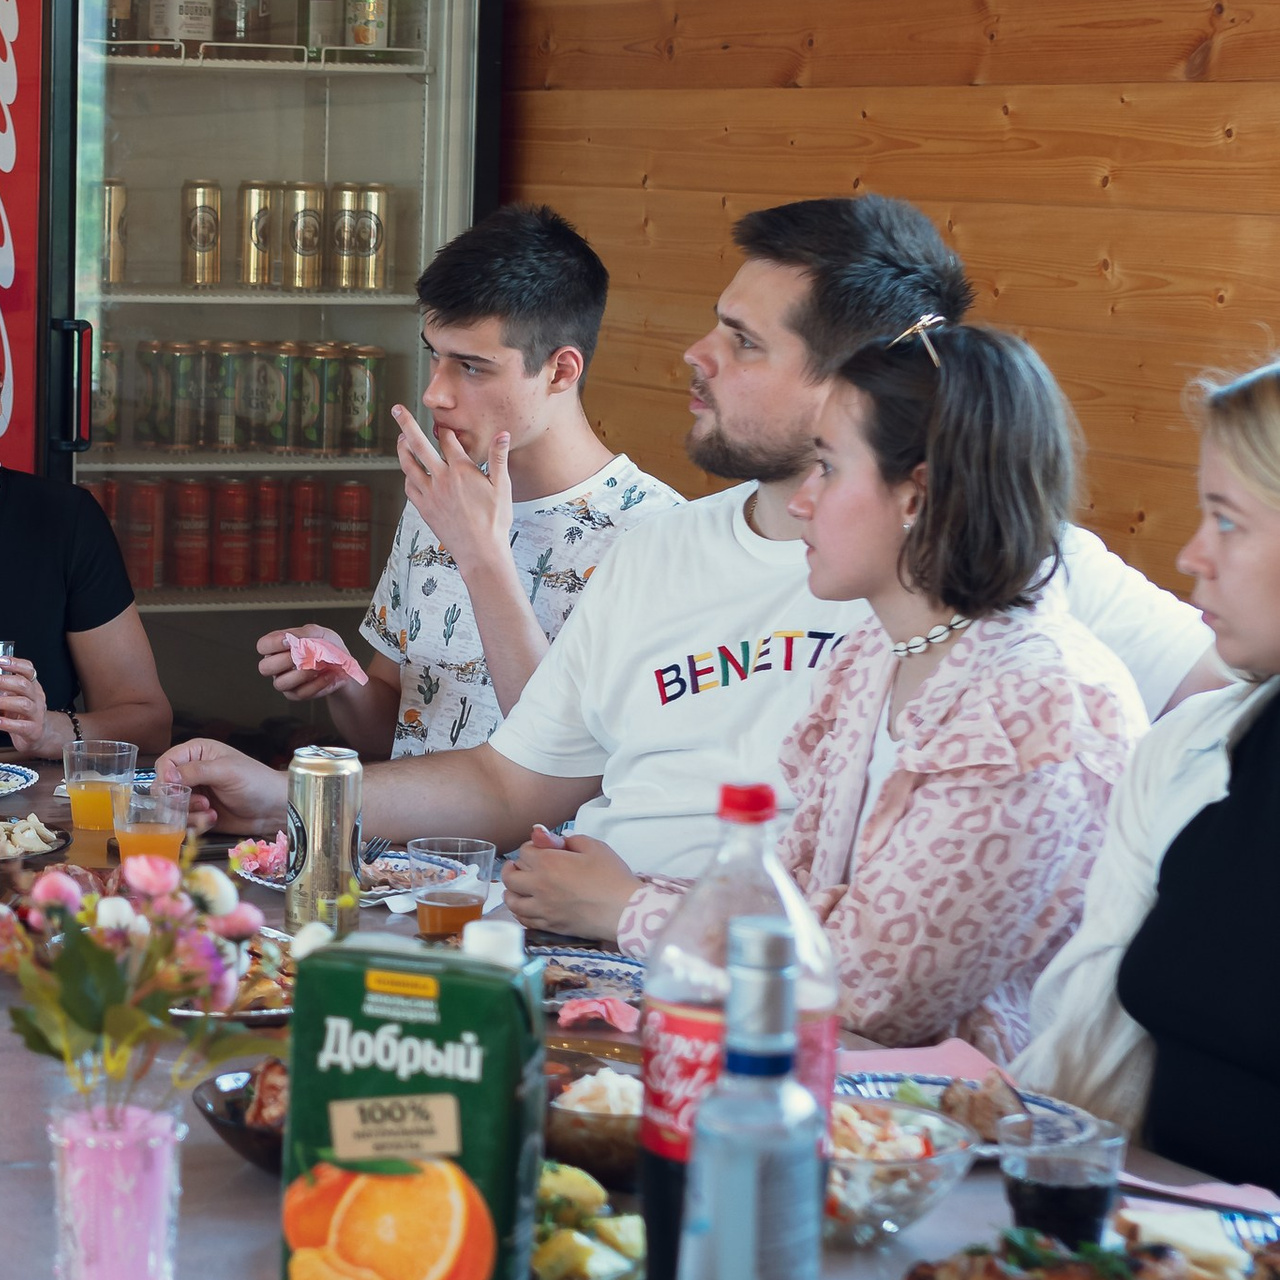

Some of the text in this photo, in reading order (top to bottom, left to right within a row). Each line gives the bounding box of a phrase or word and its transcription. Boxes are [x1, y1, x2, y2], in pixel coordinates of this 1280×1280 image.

[654, 630, 846, 706] BENETT
[317, 1015, 484, 1084] Добрый
[357, 1100, 432, 1126] 100%
